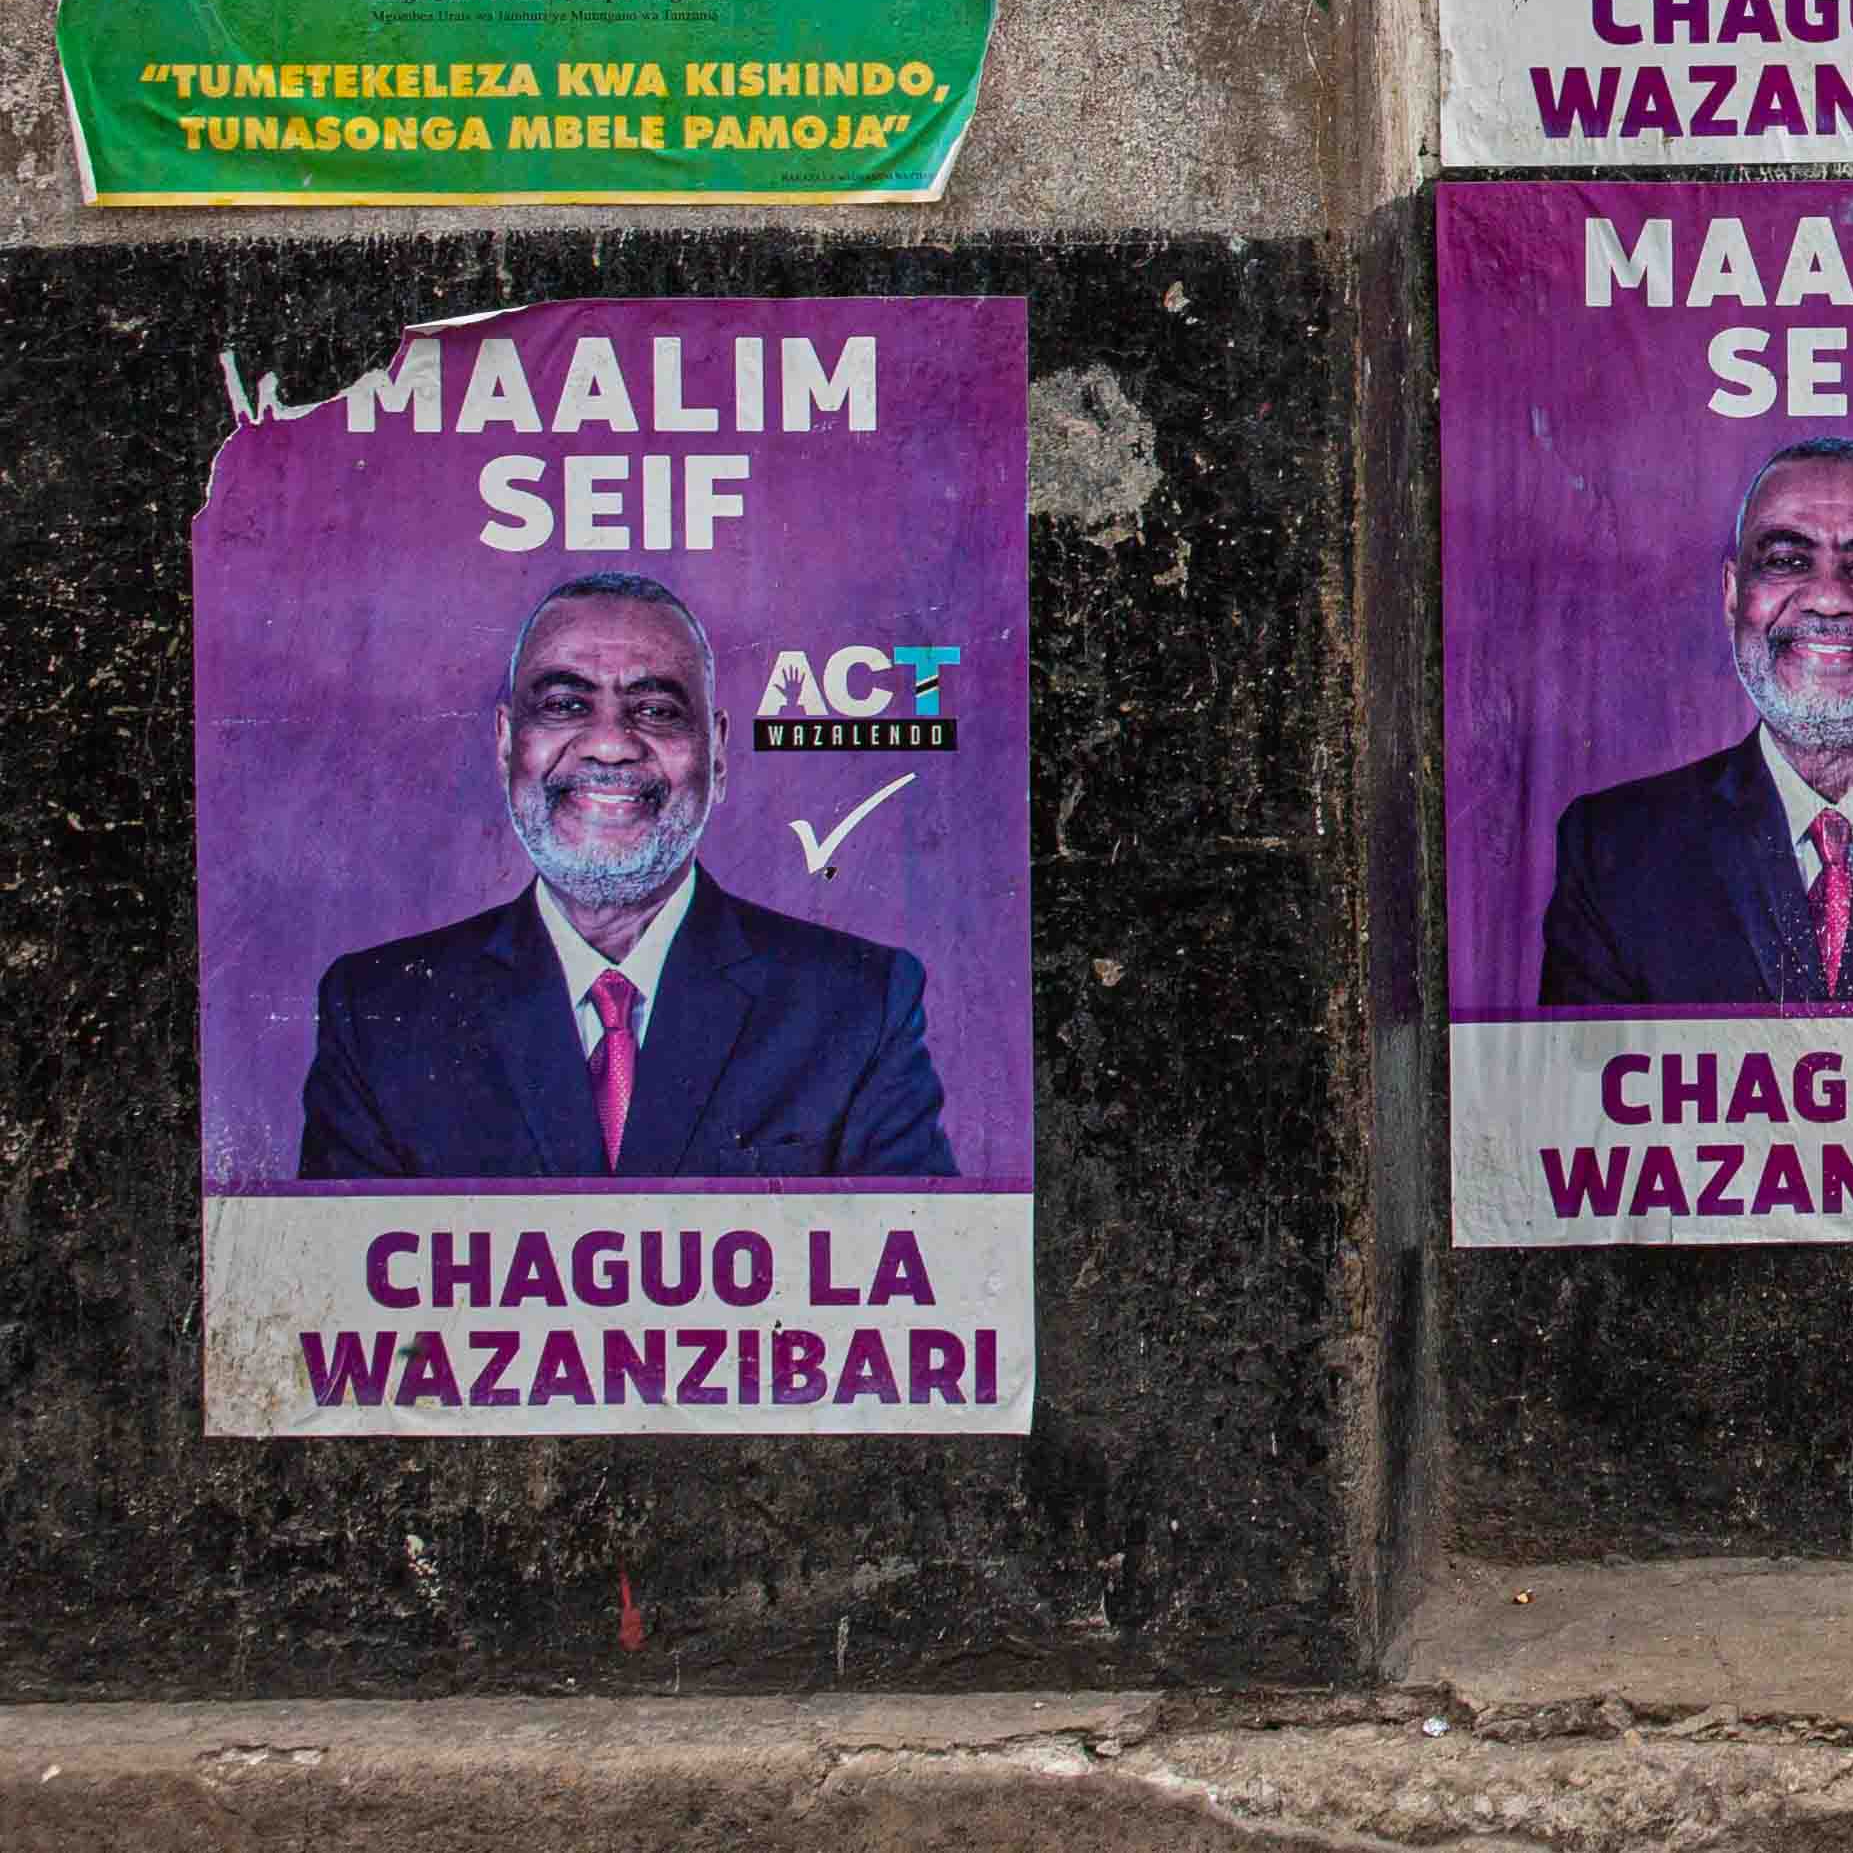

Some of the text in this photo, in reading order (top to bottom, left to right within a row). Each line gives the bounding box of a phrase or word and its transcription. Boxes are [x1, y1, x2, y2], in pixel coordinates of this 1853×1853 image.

[558, 62, 667, 100] KWA
[684, 61, 950, 108] KISHINDO,
[179, 115, 493, 152] TUNASONGA
[507, 115, 667, 151] MBELE
[346, 336, 878, 433] MAALIM
[479, 454, 751, 552] SEIF
[756, 644, 961, 717] ACT
[768, 724, 945, 747] WAZALENDO
[365, 1229, 936, 1309] CHAGUO LA
[298, 1328, 997, 1407] WAZANZIBARI
